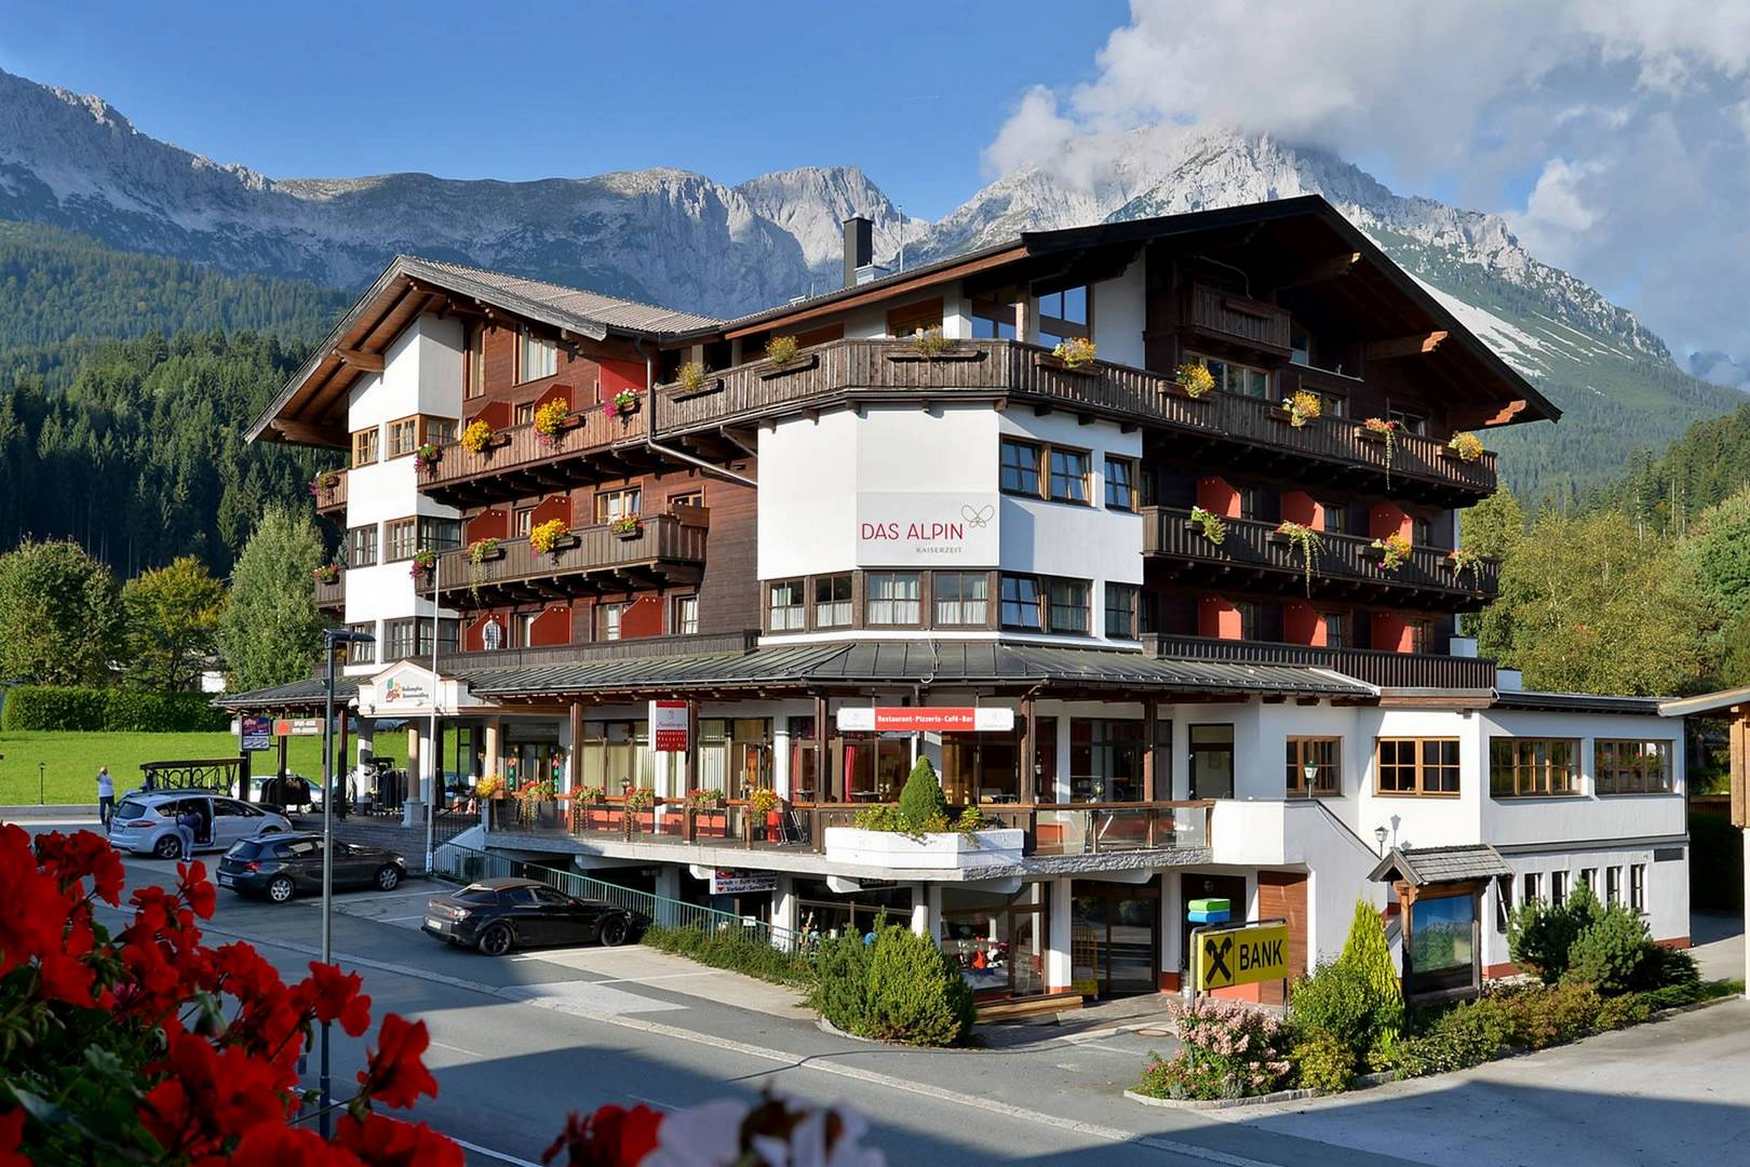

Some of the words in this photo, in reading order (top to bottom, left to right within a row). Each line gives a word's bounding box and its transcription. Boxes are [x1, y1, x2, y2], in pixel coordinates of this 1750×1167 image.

[861, 522, 900, 541] DAS
[906, 522, 964, 541] ALPIN
[916, 546, 962, 554] KAISERZEIT
[1240, 939, 1283, 971] BANK
